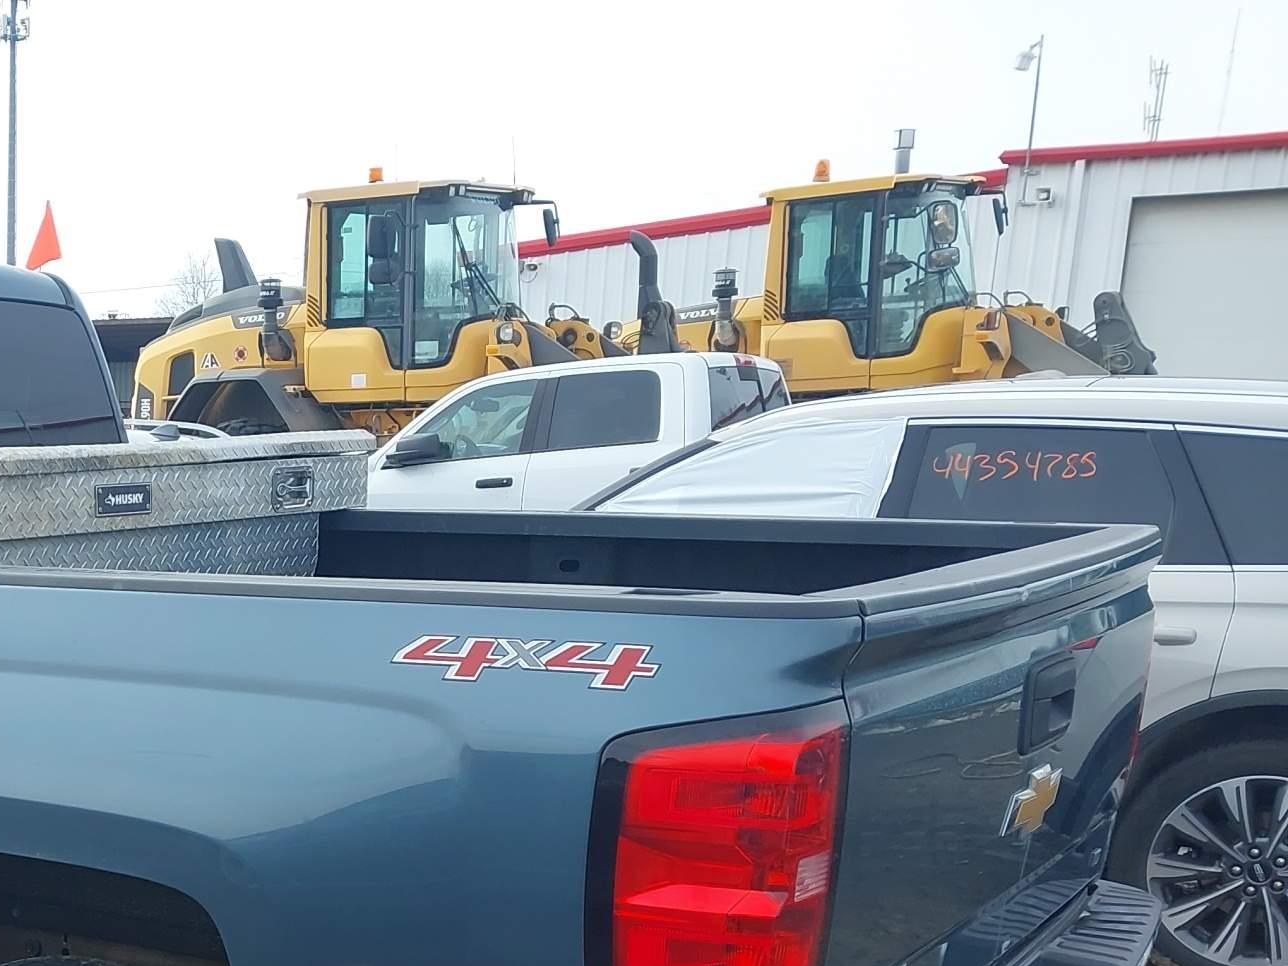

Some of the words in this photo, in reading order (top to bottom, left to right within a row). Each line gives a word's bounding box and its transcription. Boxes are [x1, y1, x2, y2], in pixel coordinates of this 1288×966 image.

[237, 311, 286, 324] VOLO
[678, 308, 718, 320] VOLV
[140, 398, 151, 420] 90H
[932, 450, 1097, 482] 44354785
[114, 492, 144, 505] HUSKY
